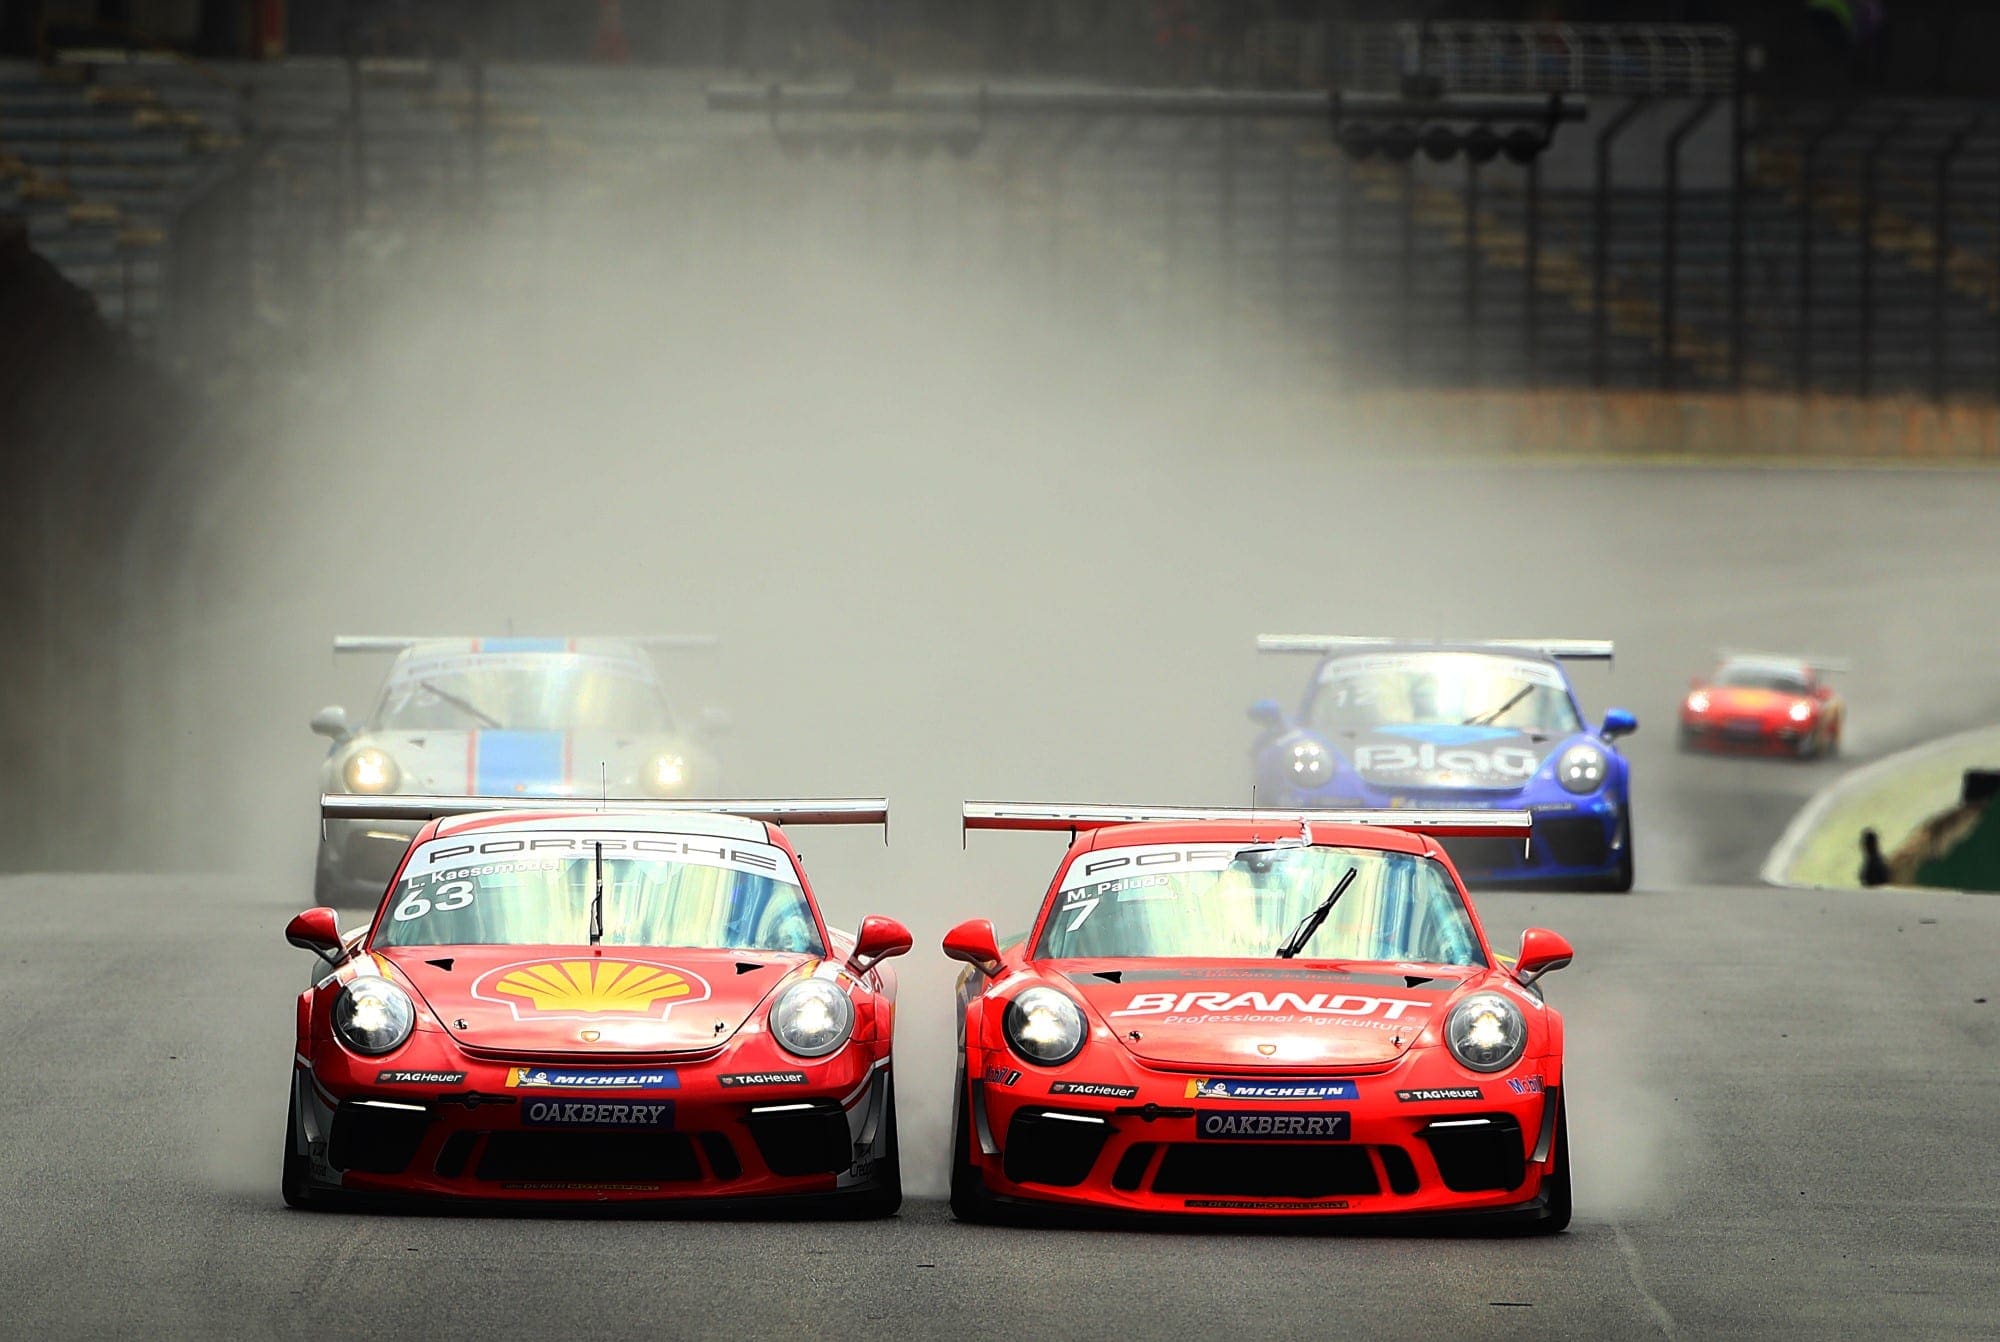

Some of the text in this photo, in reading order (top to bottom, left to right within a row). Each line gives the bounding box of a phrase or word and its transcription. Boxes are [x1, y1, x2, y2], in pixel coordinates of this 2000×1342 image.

[429, 839, 777, 871] PORSCHE
[407, 877, 426, 890] L.
[1067, 875, 1169, 903] M. Paludo
[393, 880, 474, 922] 63
[1062, 898, 1100, 932] 7
[1109, 991, 1433, 1020] BRANDT
[1163, 1012, 1294, 1025] Professional
[554, 1075, 664, 1085] MICHELIN
[1233, 1087, 1344, 1096] MICHELIN
[529, 1103, 666, 1124] OAKBERRY
[1205, 1115, 1343, 1135] OAKBERRY
